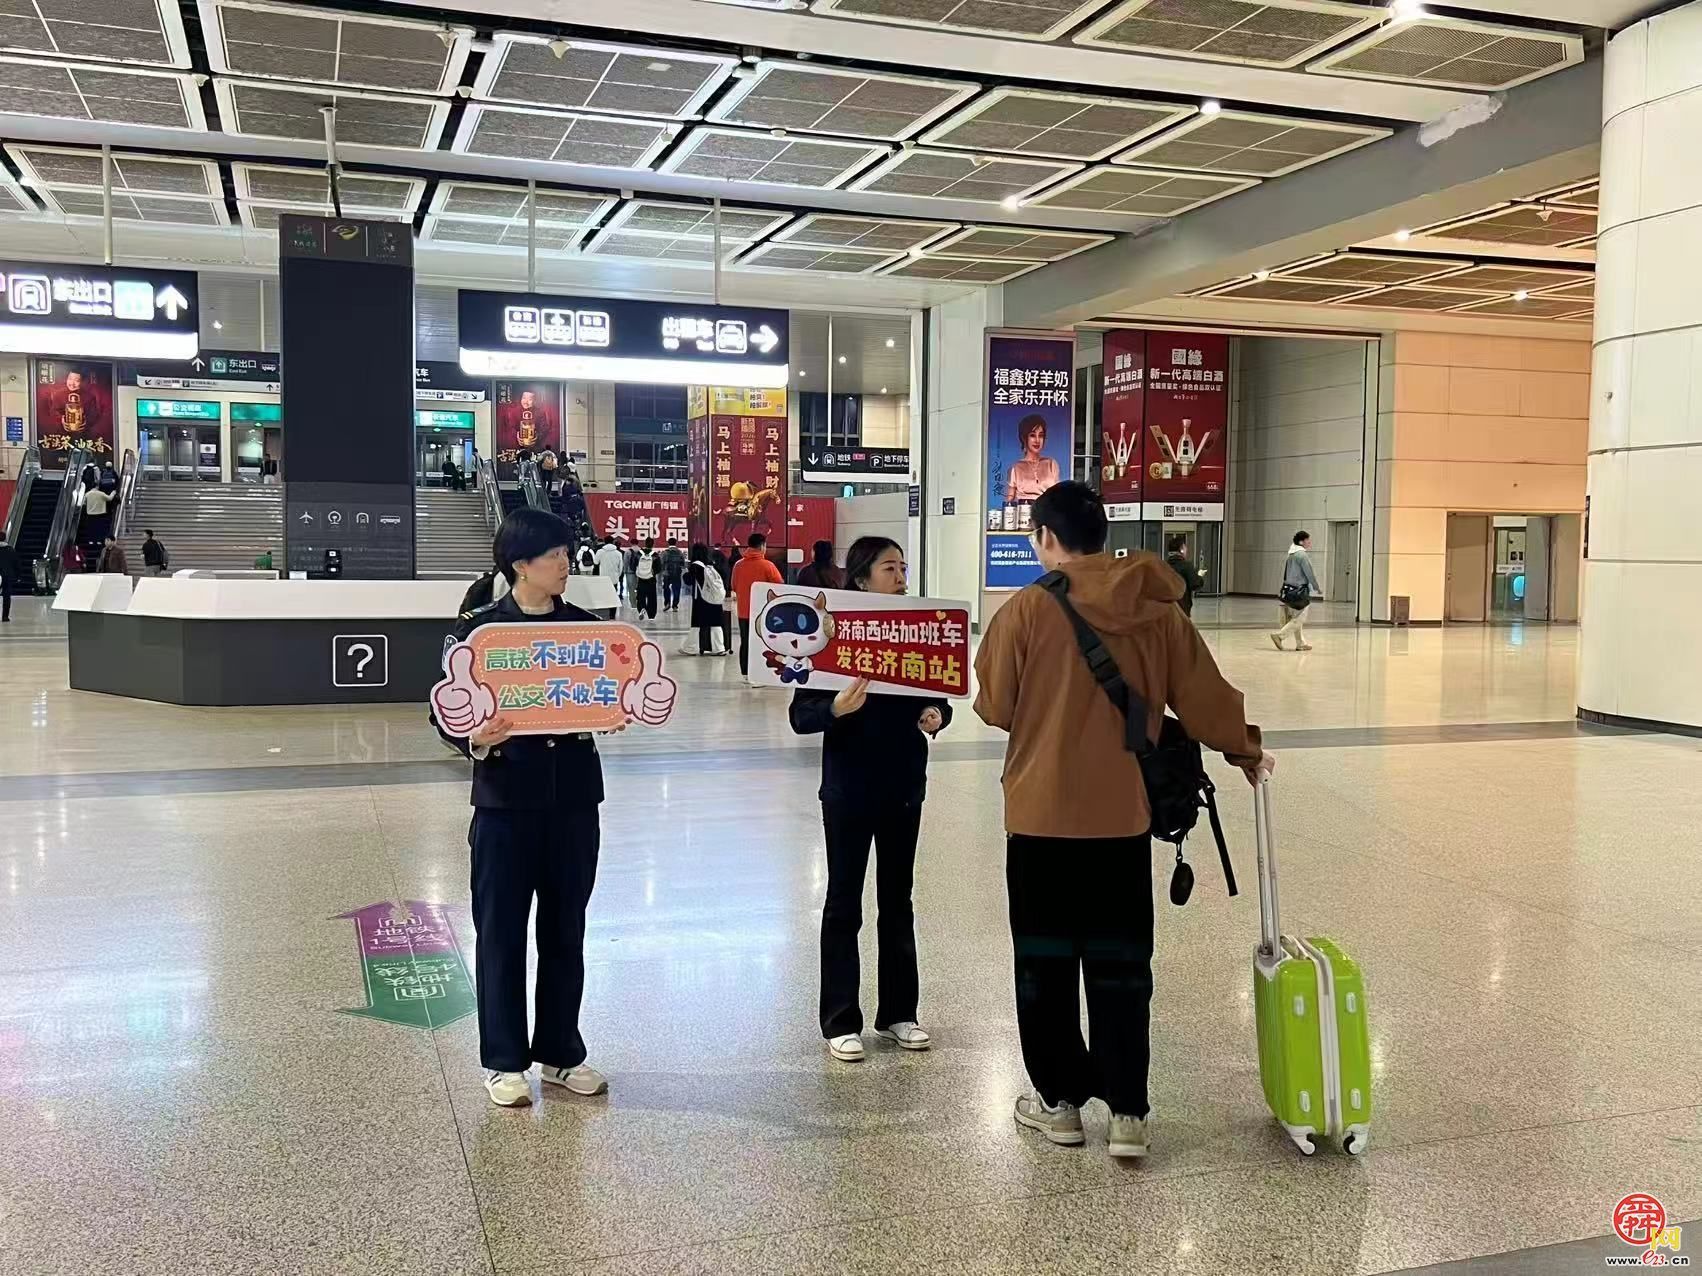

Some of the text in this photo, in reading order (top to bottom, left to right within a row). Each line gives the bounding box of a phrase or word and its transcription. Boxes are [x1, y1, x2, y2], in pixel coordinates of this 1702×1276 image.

[229, 359, 257, 368] 东出口
[993, 368, 1069, 388] 福鑫好羊奶
[1150, 368, 1224, 382] 新一代高端白酒
[993, 387, 1069, 407] 全家乐开怀
[838, 619, 965, 648] 济南西站加班车
[485, 640, 606, 671] 高铁不到站
[836, 645, 961, 687] 发往济南站
[499, 677, 619, 709] 公交不收车
[384, 973, 455, 987] 地铁
